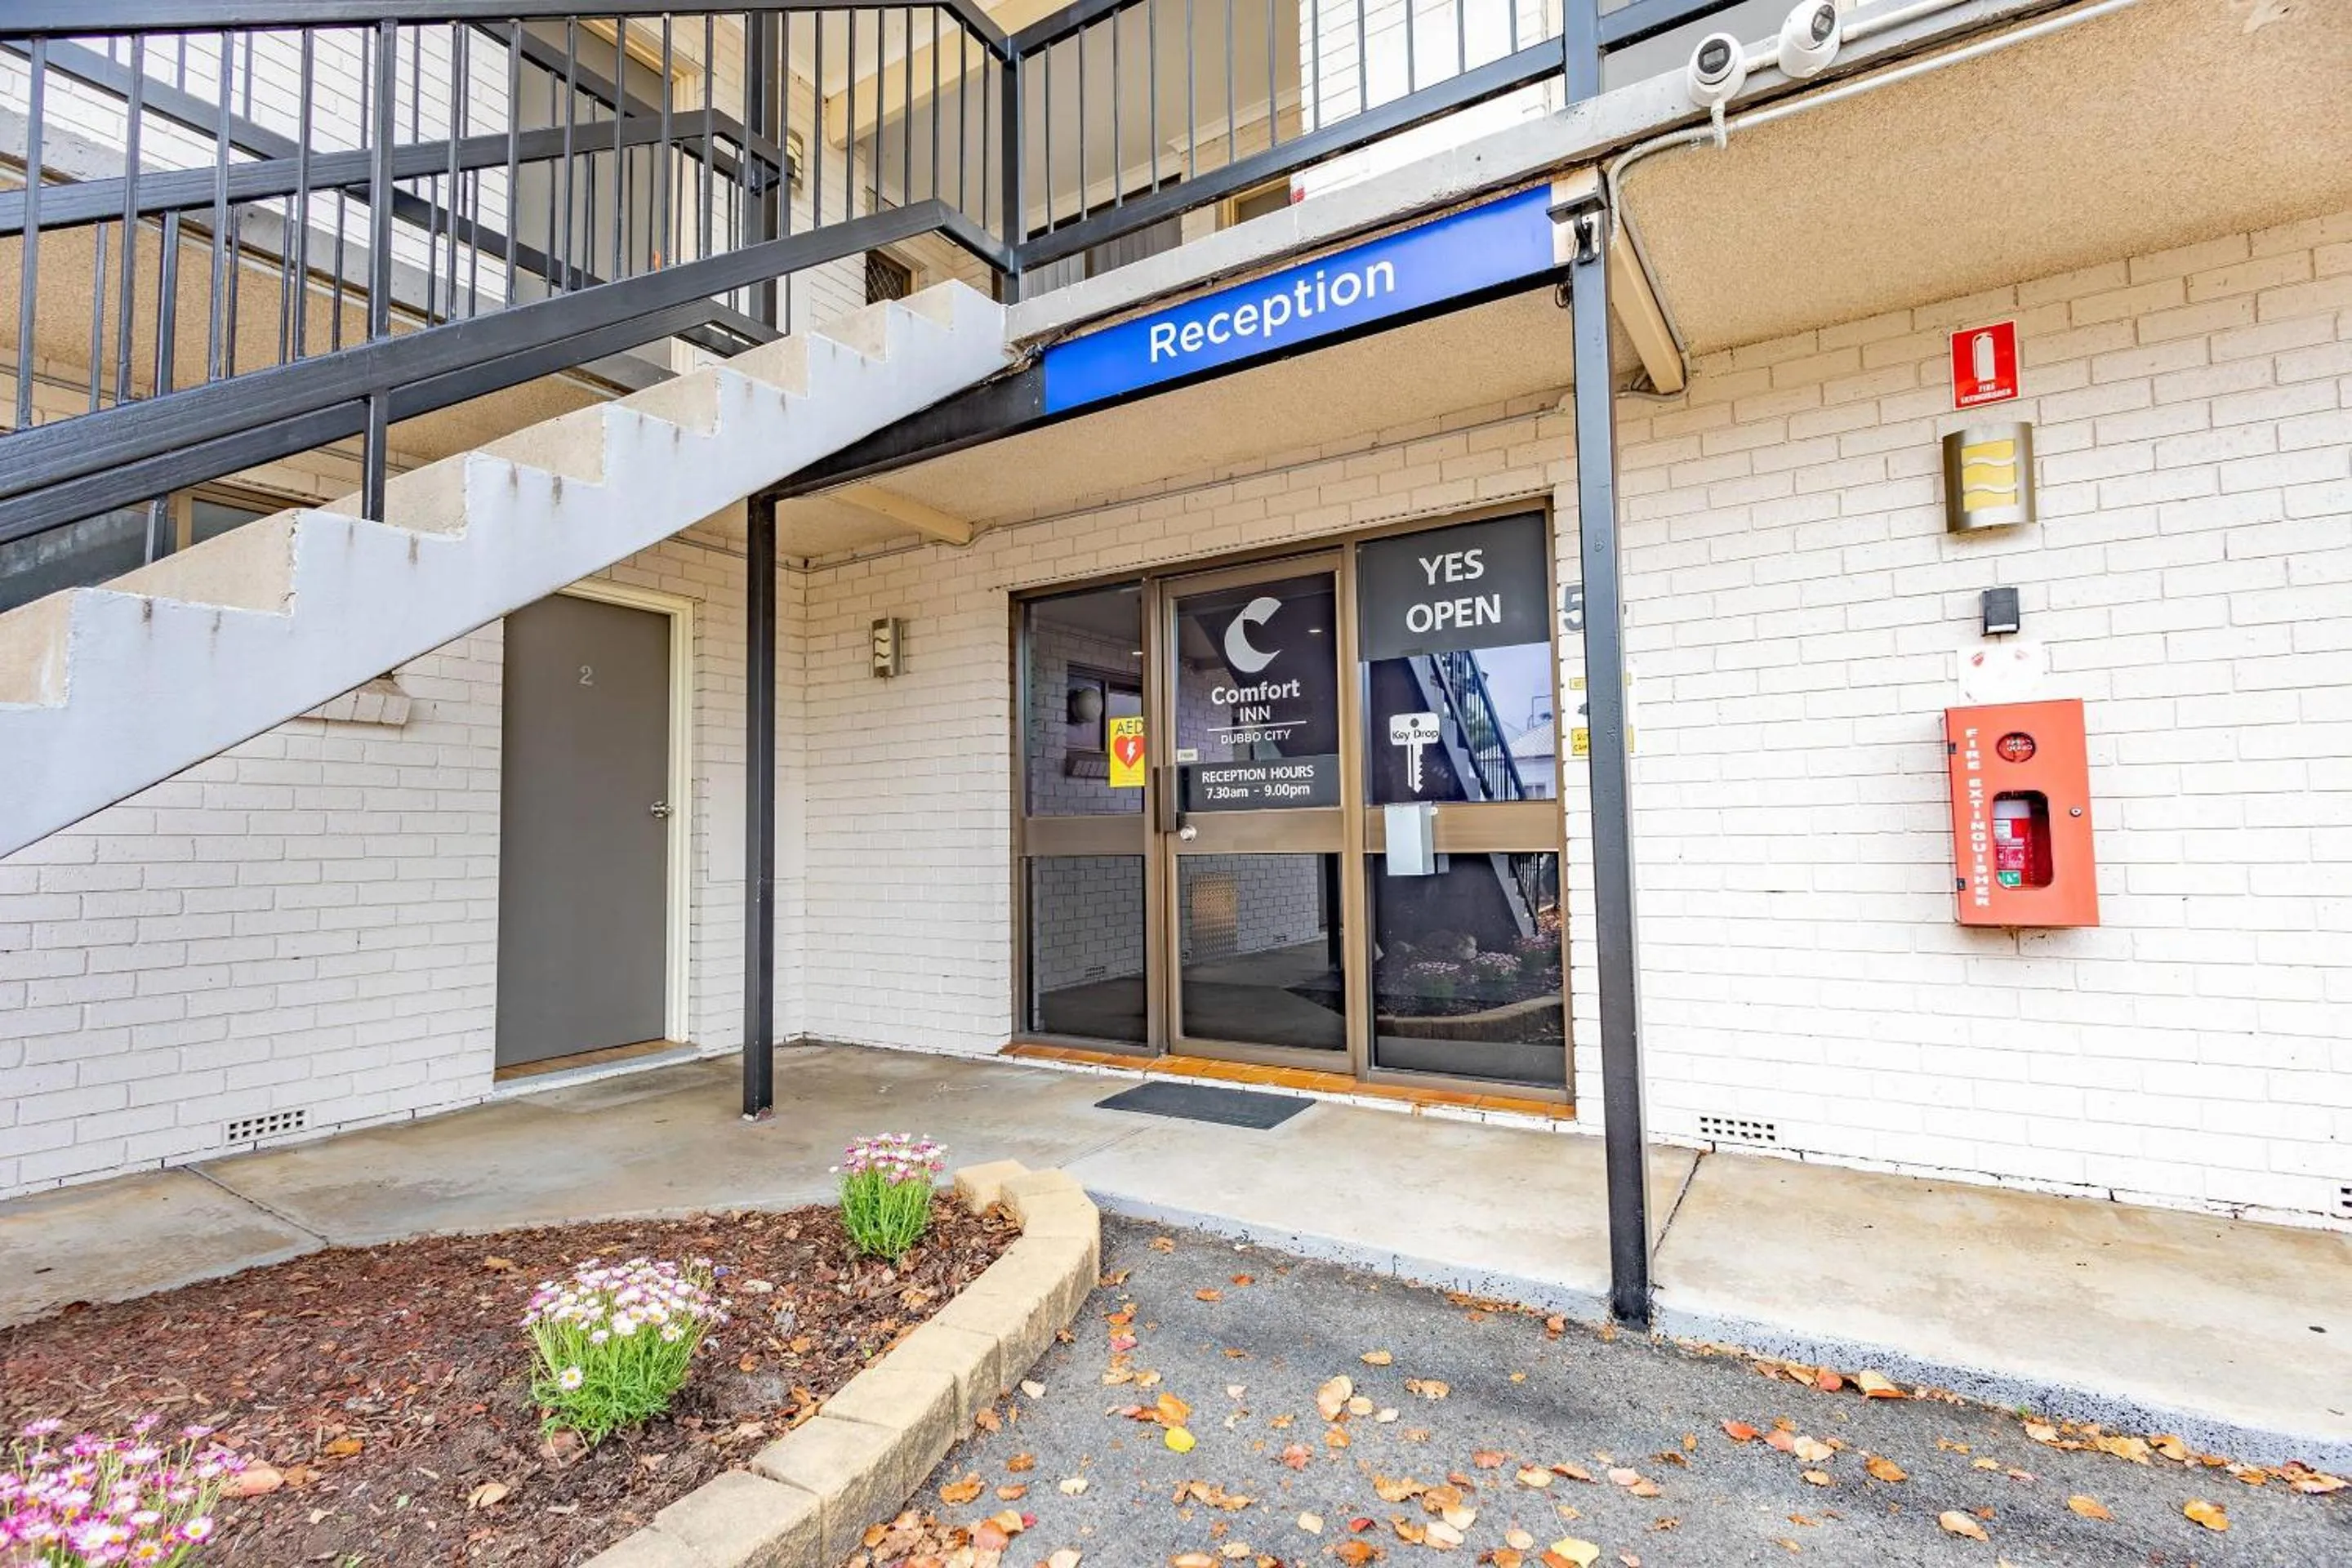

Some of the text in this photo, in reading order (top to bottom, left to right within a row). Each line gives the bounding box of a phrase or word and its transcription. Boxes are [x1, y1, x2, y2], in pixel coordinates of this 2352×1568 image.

[1150, 261, 1395, 363] Reception
[1418, 548, 1485, 586] YES
[1405, 593, 1502, 633] OPEN
[579, 665, 594, 687] 2
[1211, 679, 1301, 705] Comfort
[1239, 705, 1272, 722] INN
[1116, 719, 1144, 735] AED
[1220, 728, 1292, 745] DUBBO CITY
[1392, 728, 1439, 742] Key Drop
[1201, 764, 1315, 784] RECEPTION HOURS
[1205, 786, 1249, 800] 7.30am
[1263, 782, 1311, 799] 9.00pm
